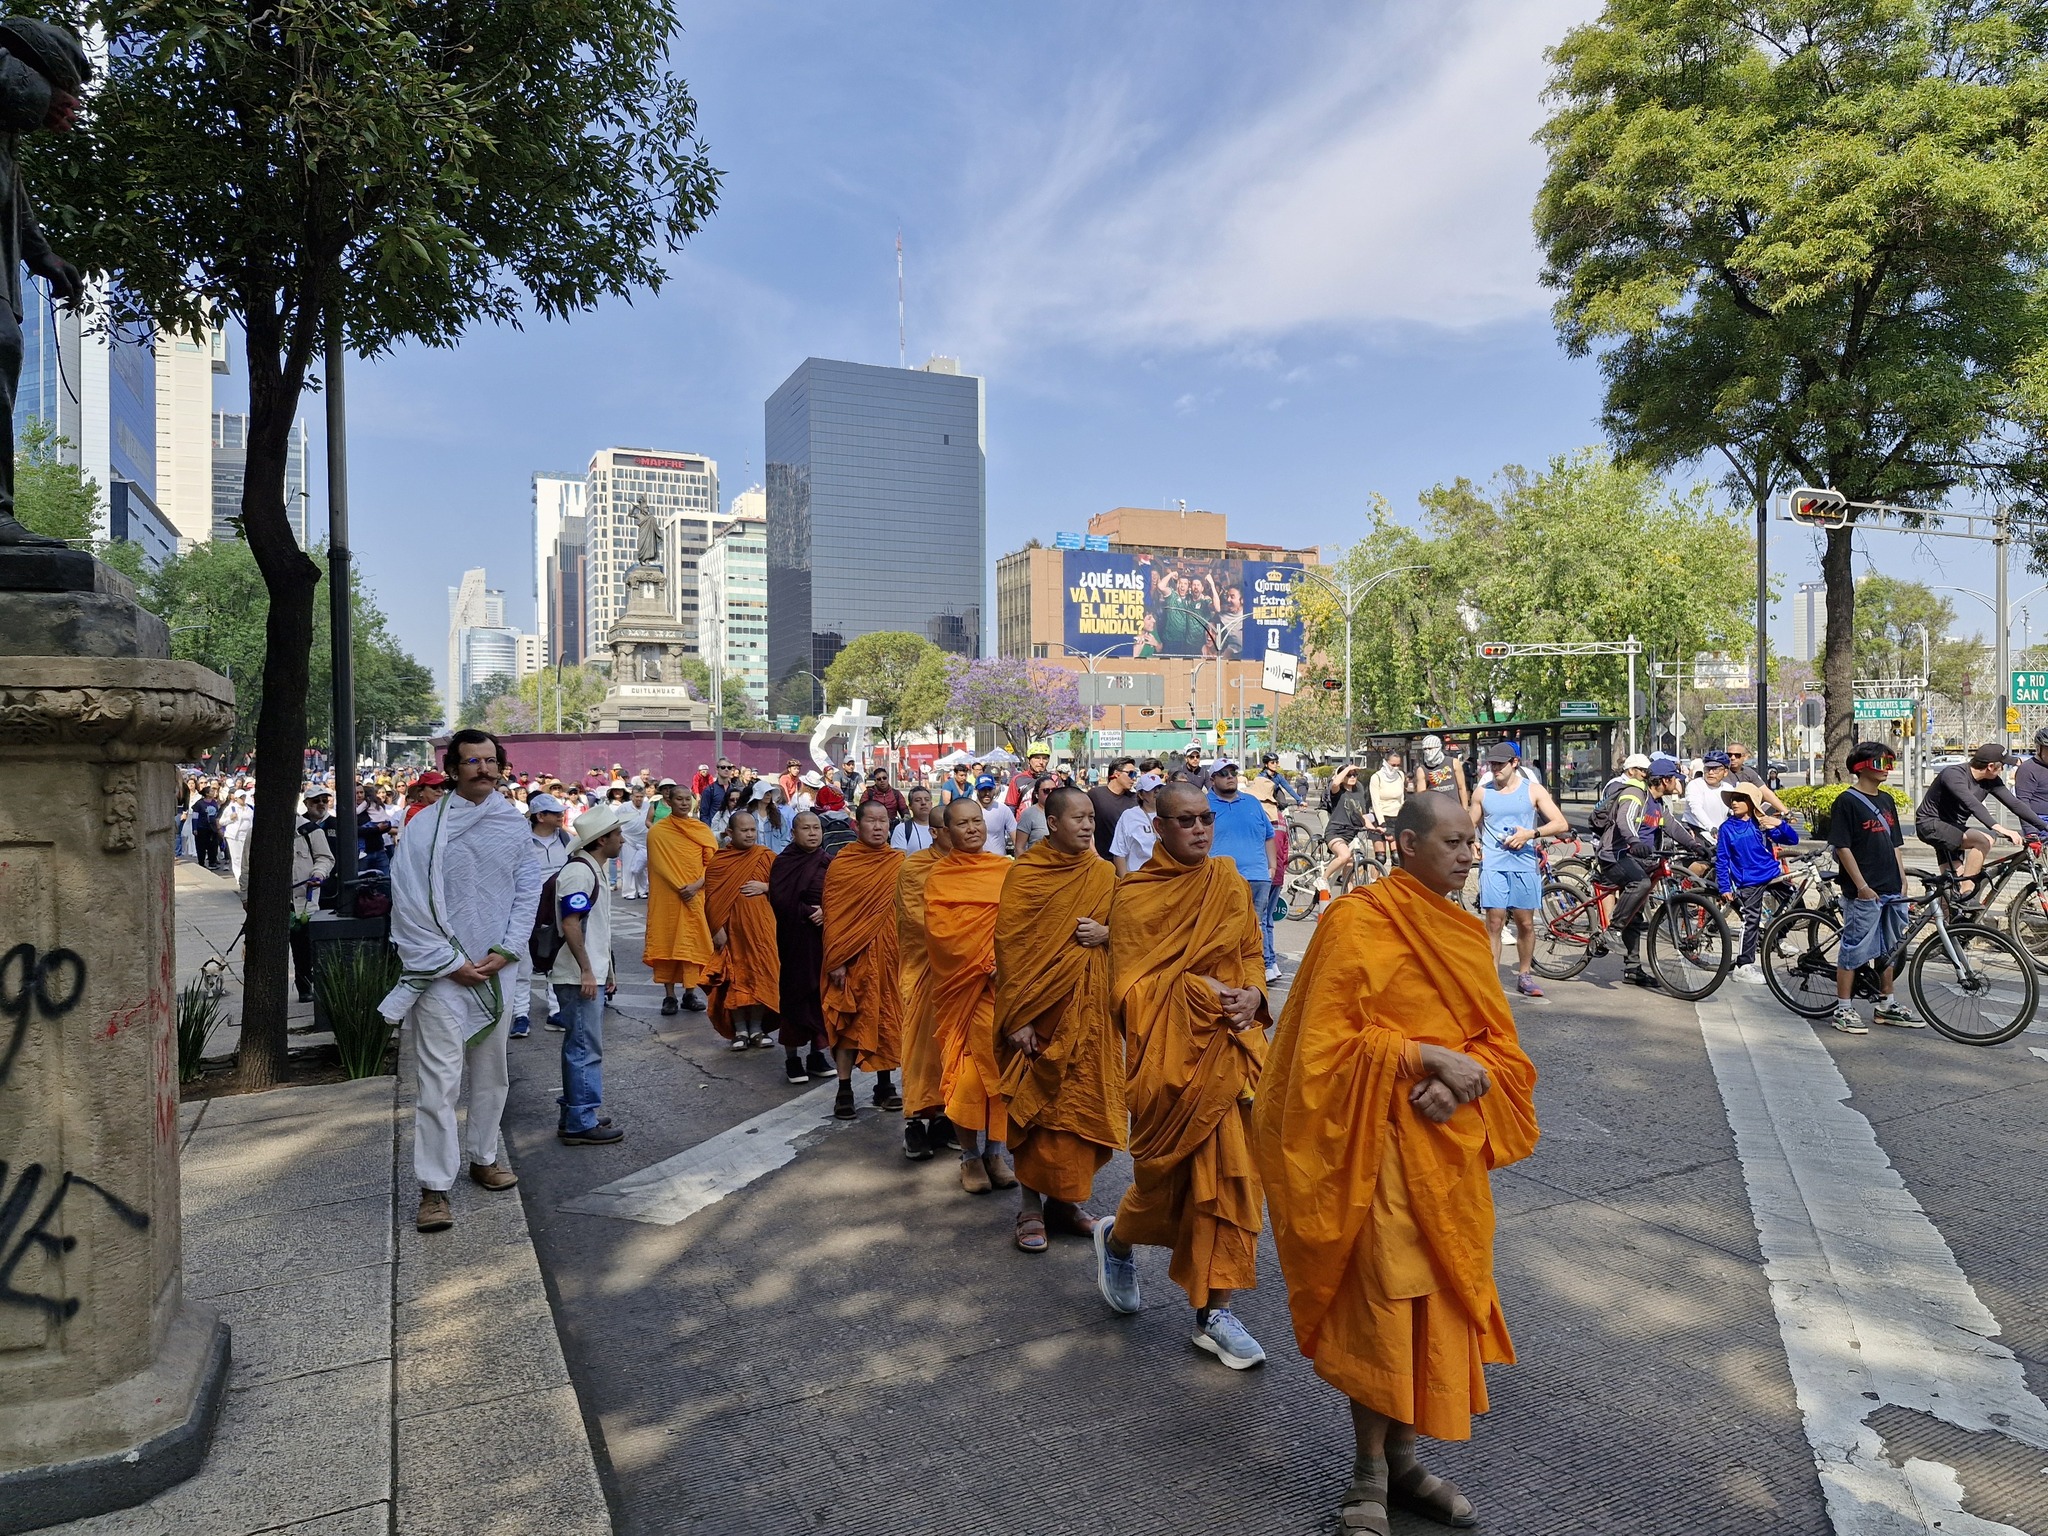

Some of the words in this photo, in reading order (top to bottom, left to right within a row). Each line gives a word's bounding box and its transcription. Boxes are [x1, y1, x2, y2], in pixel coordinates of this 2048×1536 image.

[640, 457, 685, 469] MAPFRE
[1079, 569, 1113, 590] ¿QUÉ
[1115, 570, 1144, 590] PAÍS
[1070, 587, 1088, 603] VA
[1090, 588, 1100, 603] A
[1102, 588, 1144, 605] TENER
[1260, 595, 1286, 606] Extra
[1081, 603, 1097, 618] EL
[1099, 603, 1144, 620] MEJOR
[1080, 619, 1144, 634] MUNDIAL?
[2030, 675, 2045, 687] RIO
[631, 687, 676, 695] CUITLAHUAC
[2017, 689, 2038, 701] SAN
[1864, 701, 1898, 709] INSURGENTES
[1880, 709, 1900, 717] PARIS
